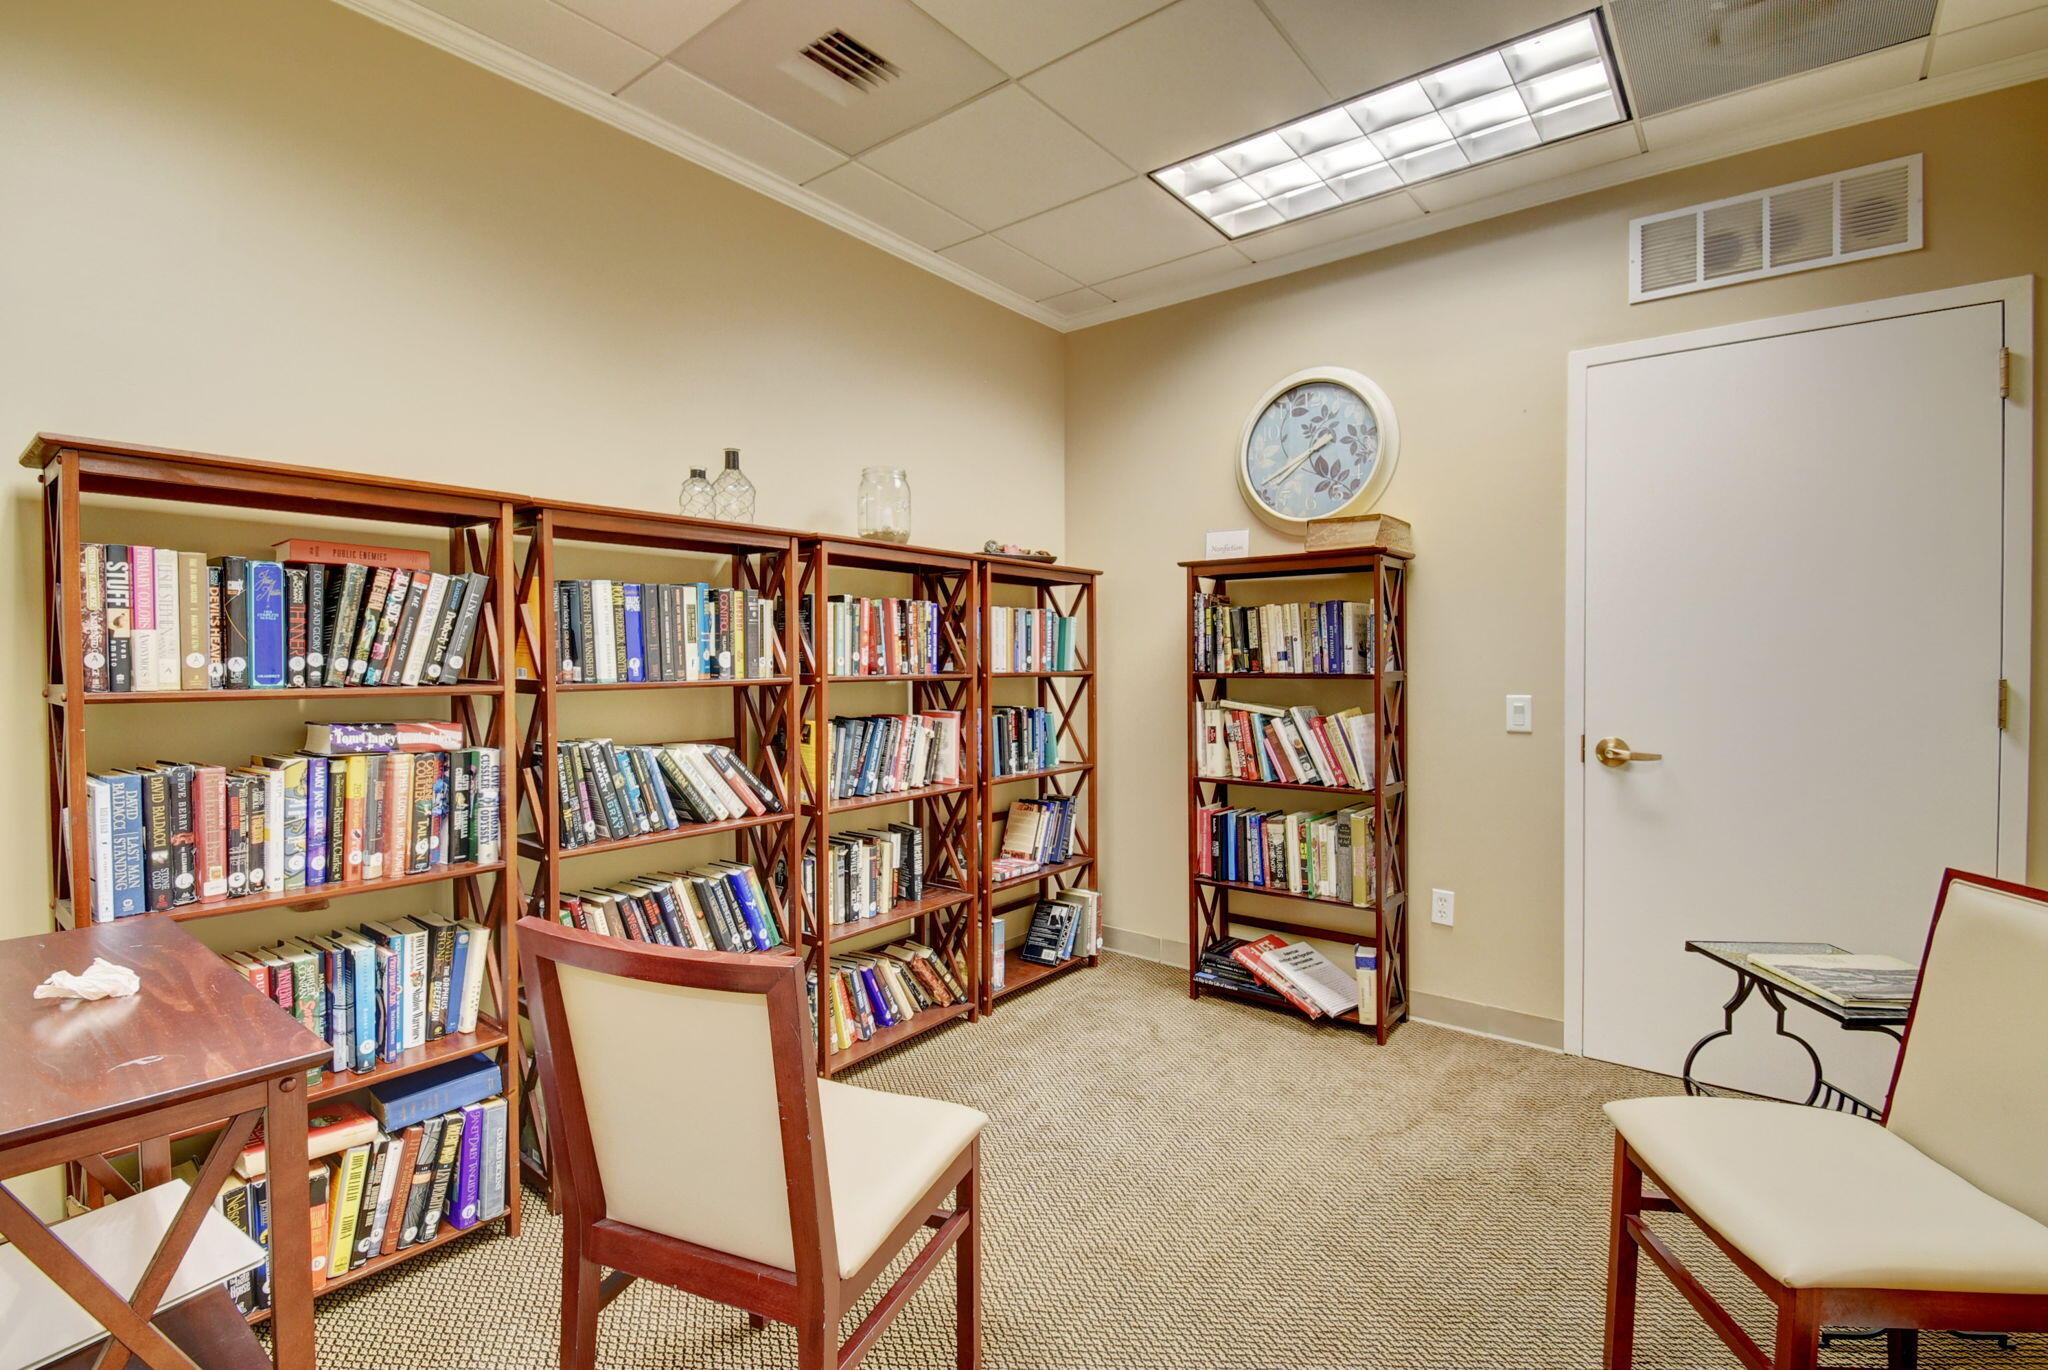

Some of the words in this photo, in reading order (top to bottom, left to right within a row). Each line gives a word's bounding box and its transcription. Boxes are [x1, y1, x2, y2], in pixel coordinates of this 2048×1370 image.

[1332, 484, 1343, 501] 5
[333, 549, 357, 558] PUBLIC
[359, 551, 387, 561] ENEMIES
[1210, 544, 1243, 553] Nonfiction
[139, 548, 150, 587] PRIMARY
[313, 570, 321, 584] FOR
[106, 560, 129, 607] STUFF
[313, 587, 321, 605] LOVE
[389, 572, 409, 602] BLIND
[140, 590, 151, 628] COLORS
[209, 586, 219, 625] DEVIL'S
[384, 601, 401, 623] SIDE
[464, 592, 479, 620] LINK
[581, 586, 590, 612] JOSEPH
[719, 593, 727, 634] CONTROL
[289, 605, 305, 656] THINNER
[312, 626, 320, 652] GLORY
[401, 616, 414, 643] LAWRENCE
[435, 609, 456, 645] Brotherly
[583, 613, 592, 639] FINDER
[614, 607, 624, 644] FREDERICK
[397, 643, 407, 661] BLOCK
[433, 644, 446, 662] Love
[584, 640, 594, 675] VANISHED
[616, 645, 626, 673] FORSYTH
[176, 771, 186, 798] STEVE
[314, 766, 324, 788] MARY
[414, 760, 425, 803] COULTER
[479, 754, 489, 788] CUSSLER
[490, 765, 499, 788] CLIVE
[591, 755, 608, 793] GREANEY
[599, 760, 611, 784] MARK
[660, 754, 676, 772] THE
[671, 767, 689, 788] FIRM
[150, 776, 164, 802] DAVID
[313, 790, 323, 807] JANE
[558, 770, 569, 803] GRAFTON
[111, 782, 125, 831] BALDACCI
[125, 790, 138, 820] DAVID
[177, 801, 187, 830] BERRY
[205, 773, 221, 832] Richard
[605, 799, 620, 829] GRAY
[151, 805, 166, 847] BALDACCI
[313, 809, 323, 834] CLARK
[332, 807, 342, 836] Richard
[479, 809, 489, 845] ODYSSEY
[489, 809, 498, 840] TROJAN
[126, 836, 139, 861] LAST
[913, 833, 921, 844] VAL
[112, 837, 127, 890] STANDING
[127, 864, 140, 888] MAN
[151, 870, 161, 889] COLD
[160, 867, 169, 890] STONE
[415, 935, 423, 947] TOM
[434, 931, 446, 962] STONE
[443, 930, 455, 962] DAVID
[297, 964, 307, 999] CONRAN
[305, 964, 317, 998] SHIRLEY
[439, 977, 450, 1010] ORPHEUS
[429, 980, 443, 1021] DECEPTION
[412, 1011, 422, 1039] Warriors
[468, 1111, 479, 1135] JANET
[467, 1135, 479, 1160] DAILEY
[495, 1127, 504, 1160] CHARLES
[350, 1153, 363, 1171] DON
[434, 1166, 450, 1184] LEN
[494, 1160, 502, 1191] DICKENS
[345, 1170, 361, 1202] DELILLO
[339, 1213, 354, 1241] LIBRA
